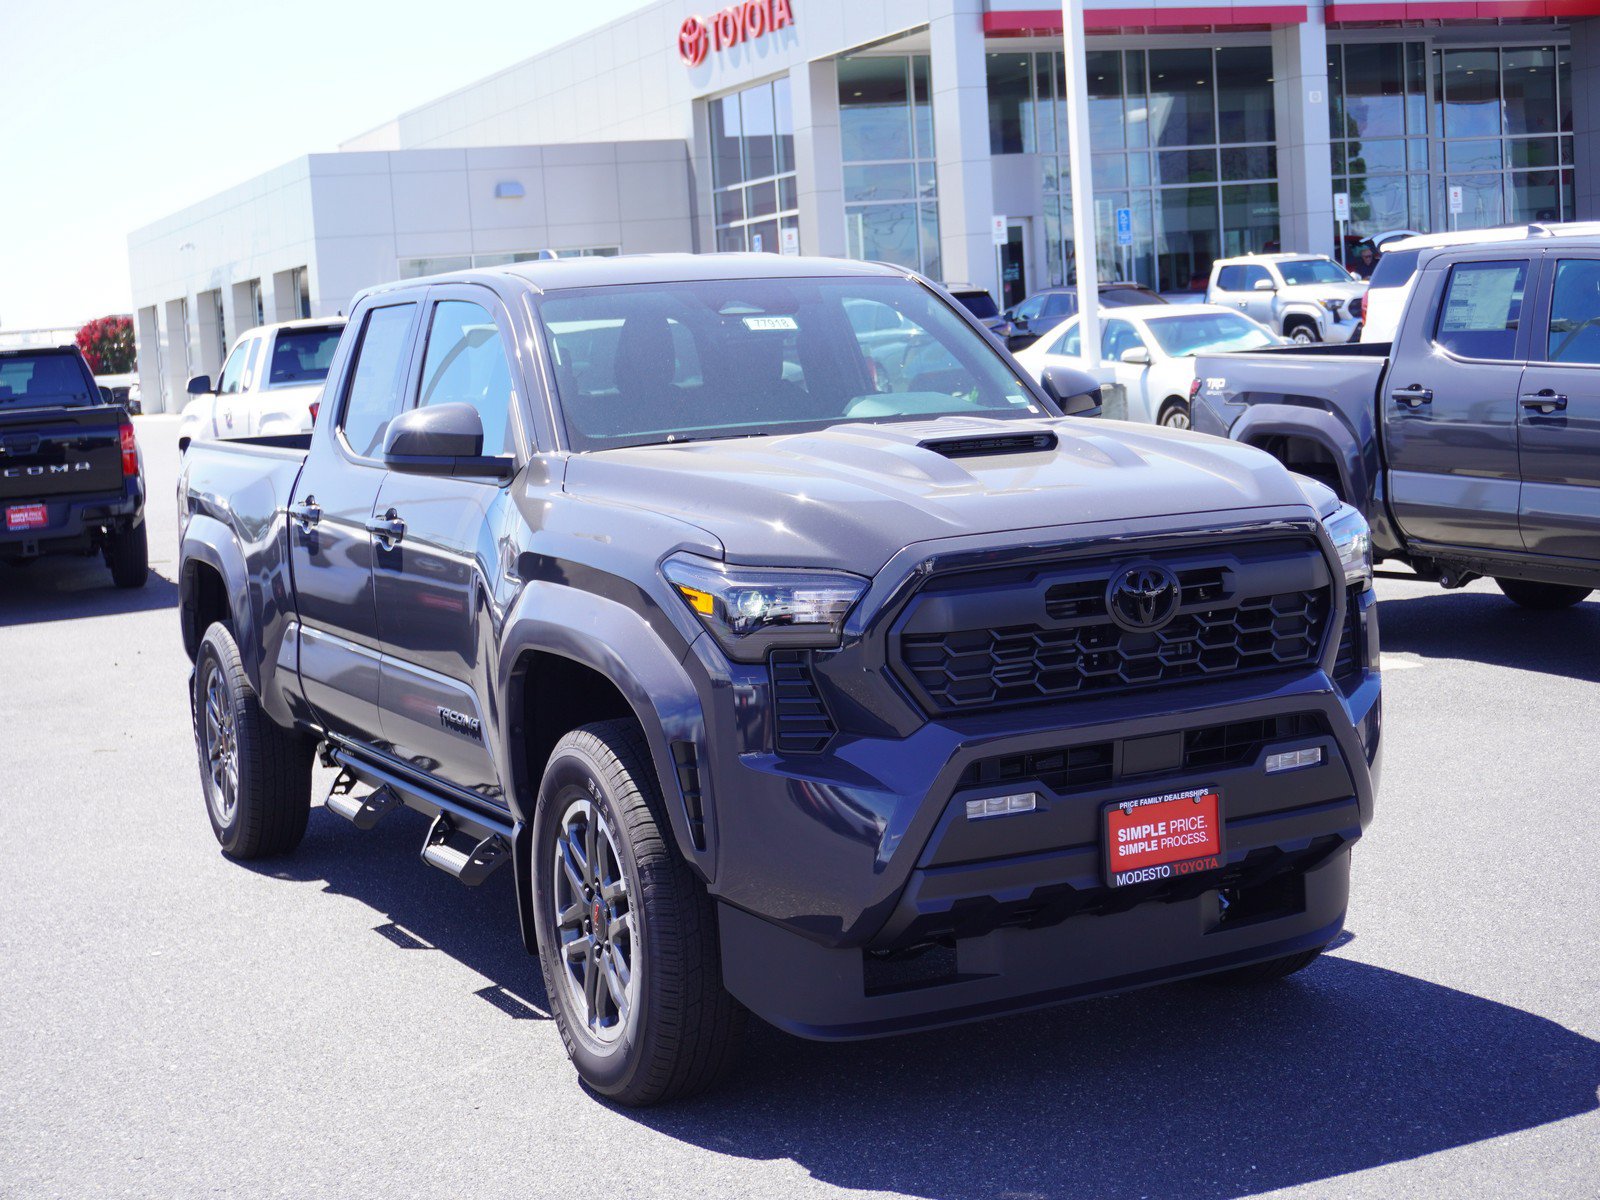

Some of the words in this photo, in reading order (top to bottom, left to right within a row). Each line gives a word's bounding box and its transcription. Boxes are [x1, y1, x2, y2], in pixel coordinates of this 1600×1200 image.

[706, 0, 794, 51] TOYOTA
[753, 319, 790, 328] 77918
[1206, 377, 1226, 390] TRD
[436, 705, 480, 731] TACOMA
[1120, 800, 1139, 809] PRICE
[1140, 796, 1163, 806] FAMILY
[1164, 788, 1209, 802] DEALERSHIPS
[1118, 822, 1166, 842] SIMPLE
[1170, 815, 1208, 833] PRICE.
[1118, 840, 1158, 856] SIMPLE
[1160, 832, 1209, 849] PROCESS.
[1116, 865, 1171, 887] MODESTO
[1173, 858, 1219, 876] TOYOTA
